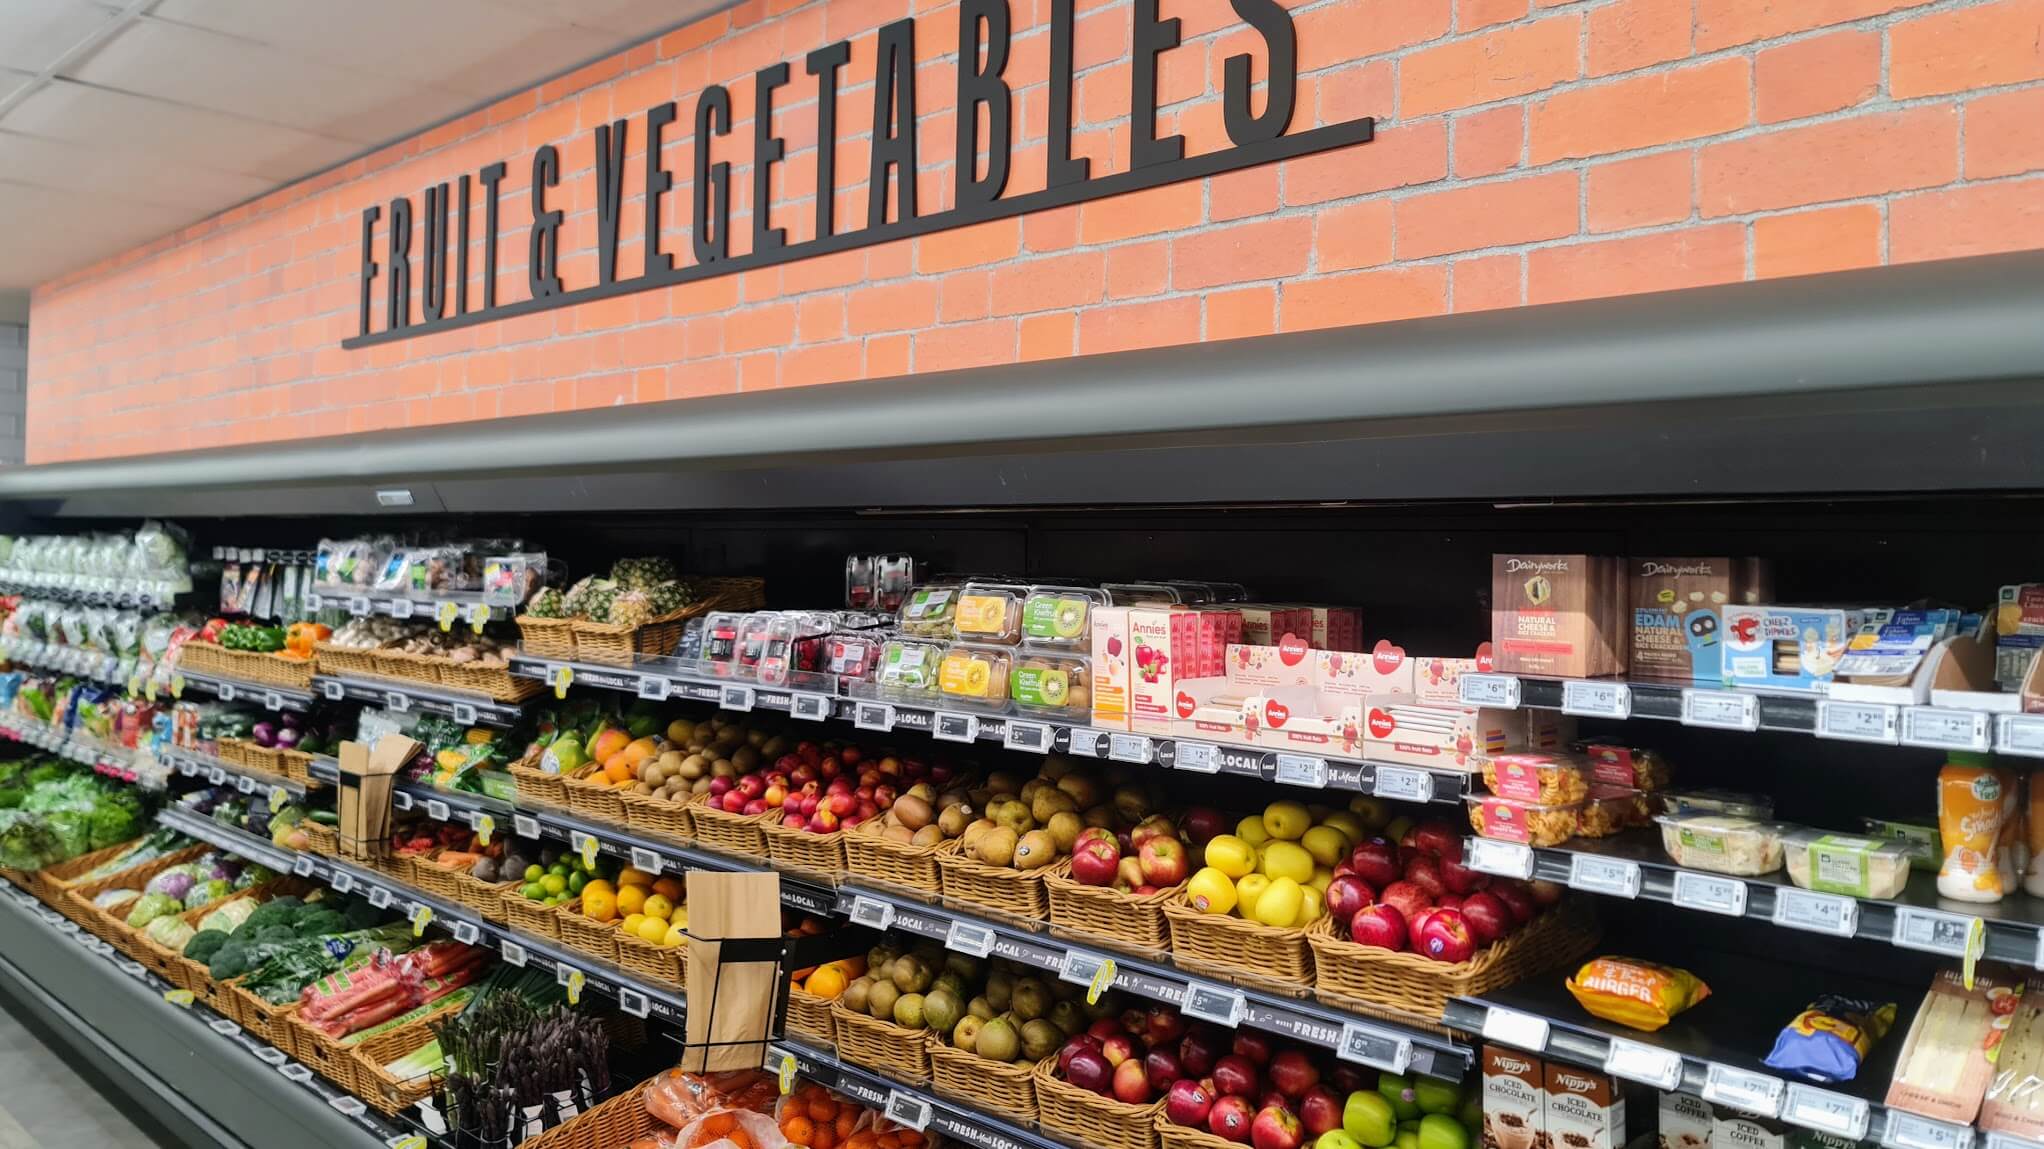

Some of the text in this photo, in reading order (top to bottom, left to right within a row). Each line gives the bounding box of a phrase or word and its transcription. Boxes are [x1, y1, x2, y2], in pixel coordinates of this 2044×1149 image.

[360, 0, 1298, 337] FRUIT & VEGETABLES
[1505, 558, 1569, 574] Dairyworks
[1518, 616, 1556, 624] NATURAL
[1518, 624, 1548, 632] CHEESE
[1635, 614, 1681, 627] EDAM
[1132, 622, 1167, 635] Annies
[1635, 627, 1683, 636] NATURAL
[1635, 634, 1674, 644] CHEESE
[901, 713, 927, 725] LOCAL
[1221, 753, 1258, 770] LOCAL
[792, 894, 815, 908] LOCAL
[897, 915, 923, 931] LOCAL
[996, 941, 1020, 958] OCAL
[1293, 1020, 1337, 1044] FRESH
[1492, 1055, 1532, 1075] Nippy's
[1503, 1079, 1522, 1090] ICED
[1555, 1072, 1598, 1093] Nippy's
[857, 1086, 883, 1103] FRESH
[1489, 1083, 1536, 1102] CHOCOLATE
[1567, 1096, 1587, 1109] ICED
[1680, 1096, 1702, 1109] ICED
[1551, 1102, 1603, 1121] CHOCOLATE
[1674, 1103, 1707, 1119] COFFEE
[948, 1120, 978, 1140] FRESH
[1736, 1122, 1760, 1136] ICED
[1730, 1130, 1766, 1148] COFFEE
